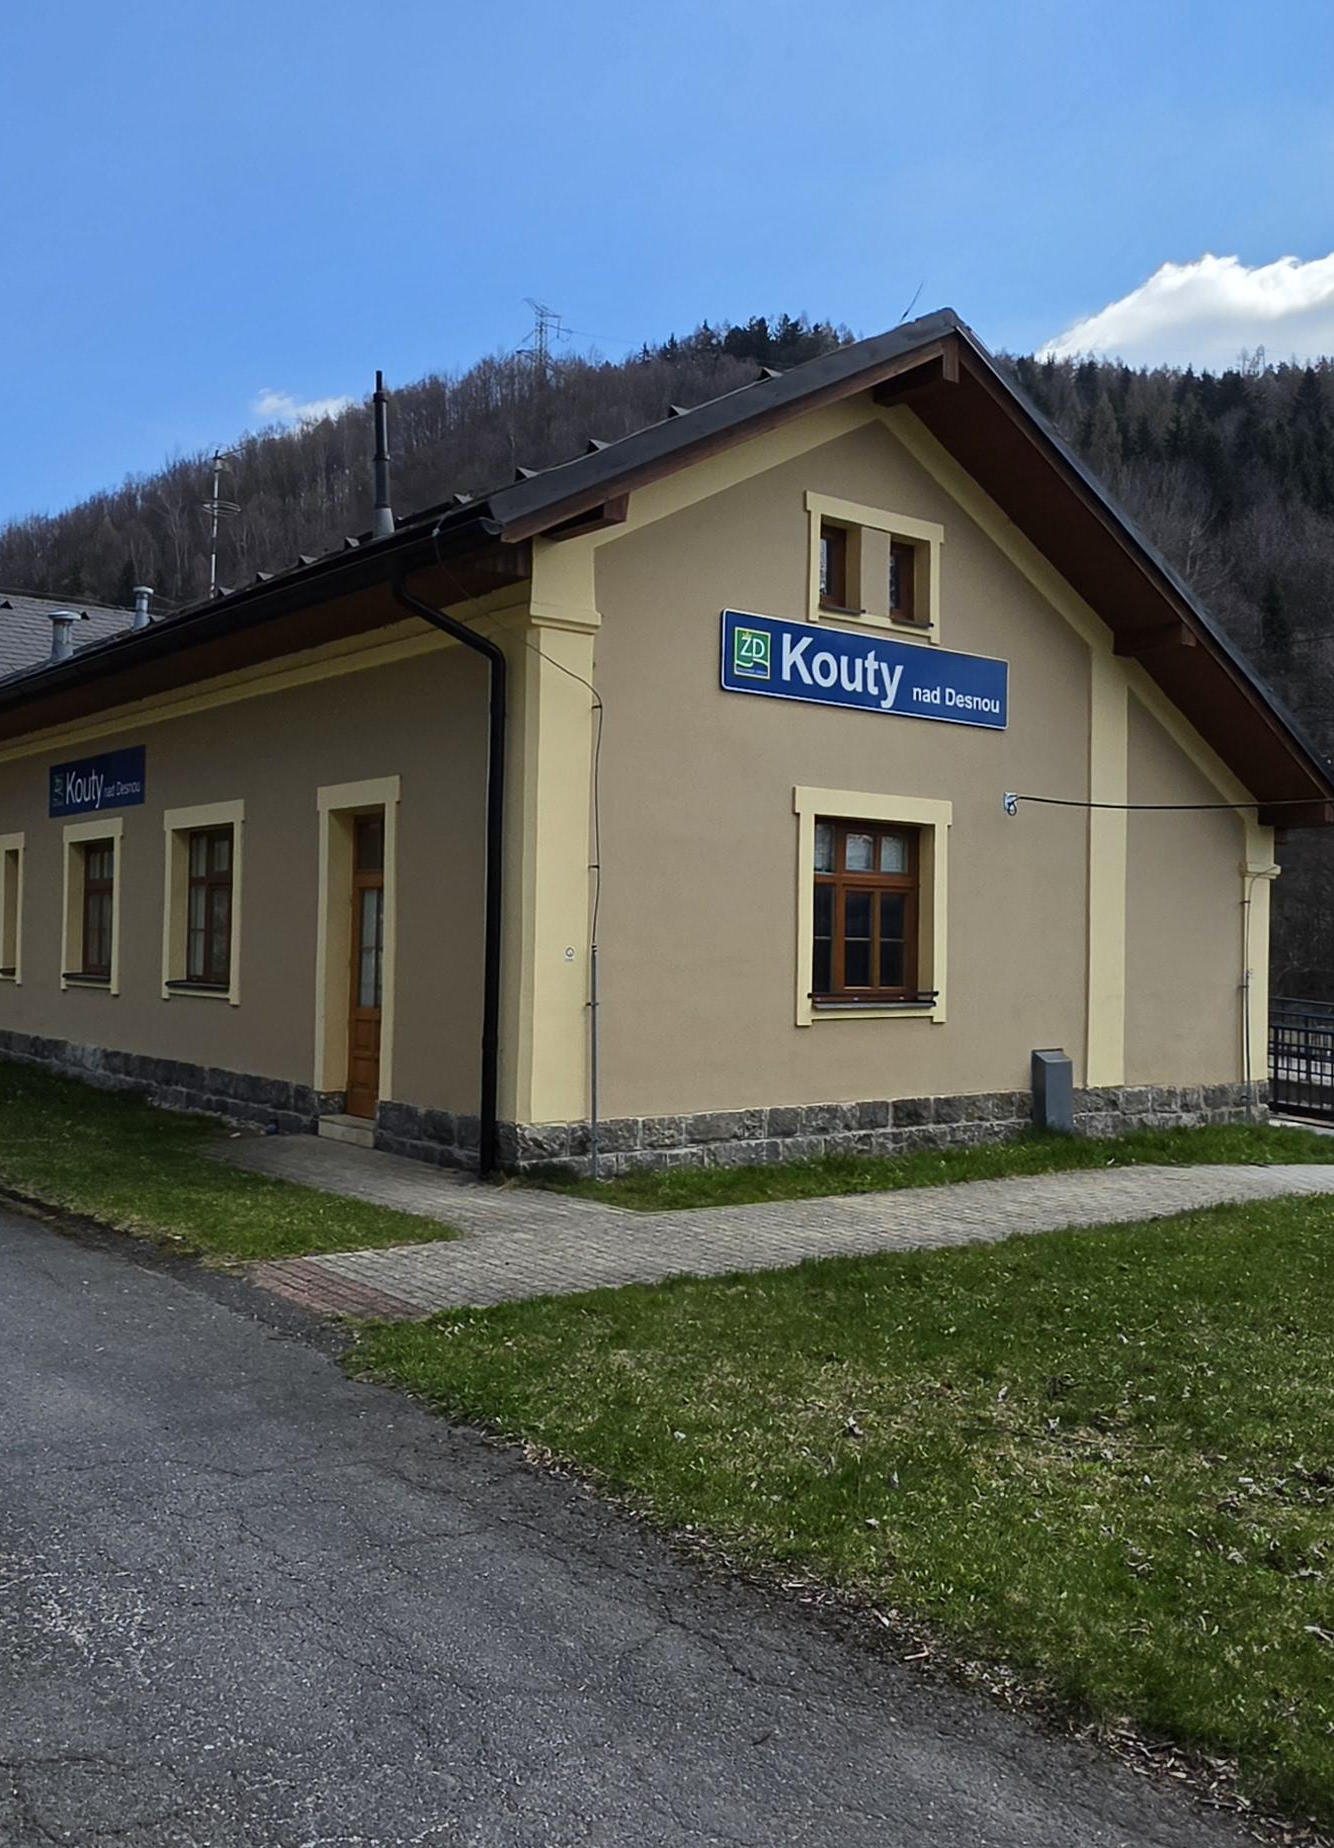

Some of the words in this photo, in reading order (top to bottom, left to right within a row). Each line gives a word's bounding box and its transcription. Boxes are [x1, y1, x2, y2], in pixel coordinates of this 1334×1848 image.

[781, 633, 904, 708] Kouty
[913, 685, 941, 705] nad
[945, 688, 1000, 713] Desnou
[65, 768, 104, 809] Kouty
